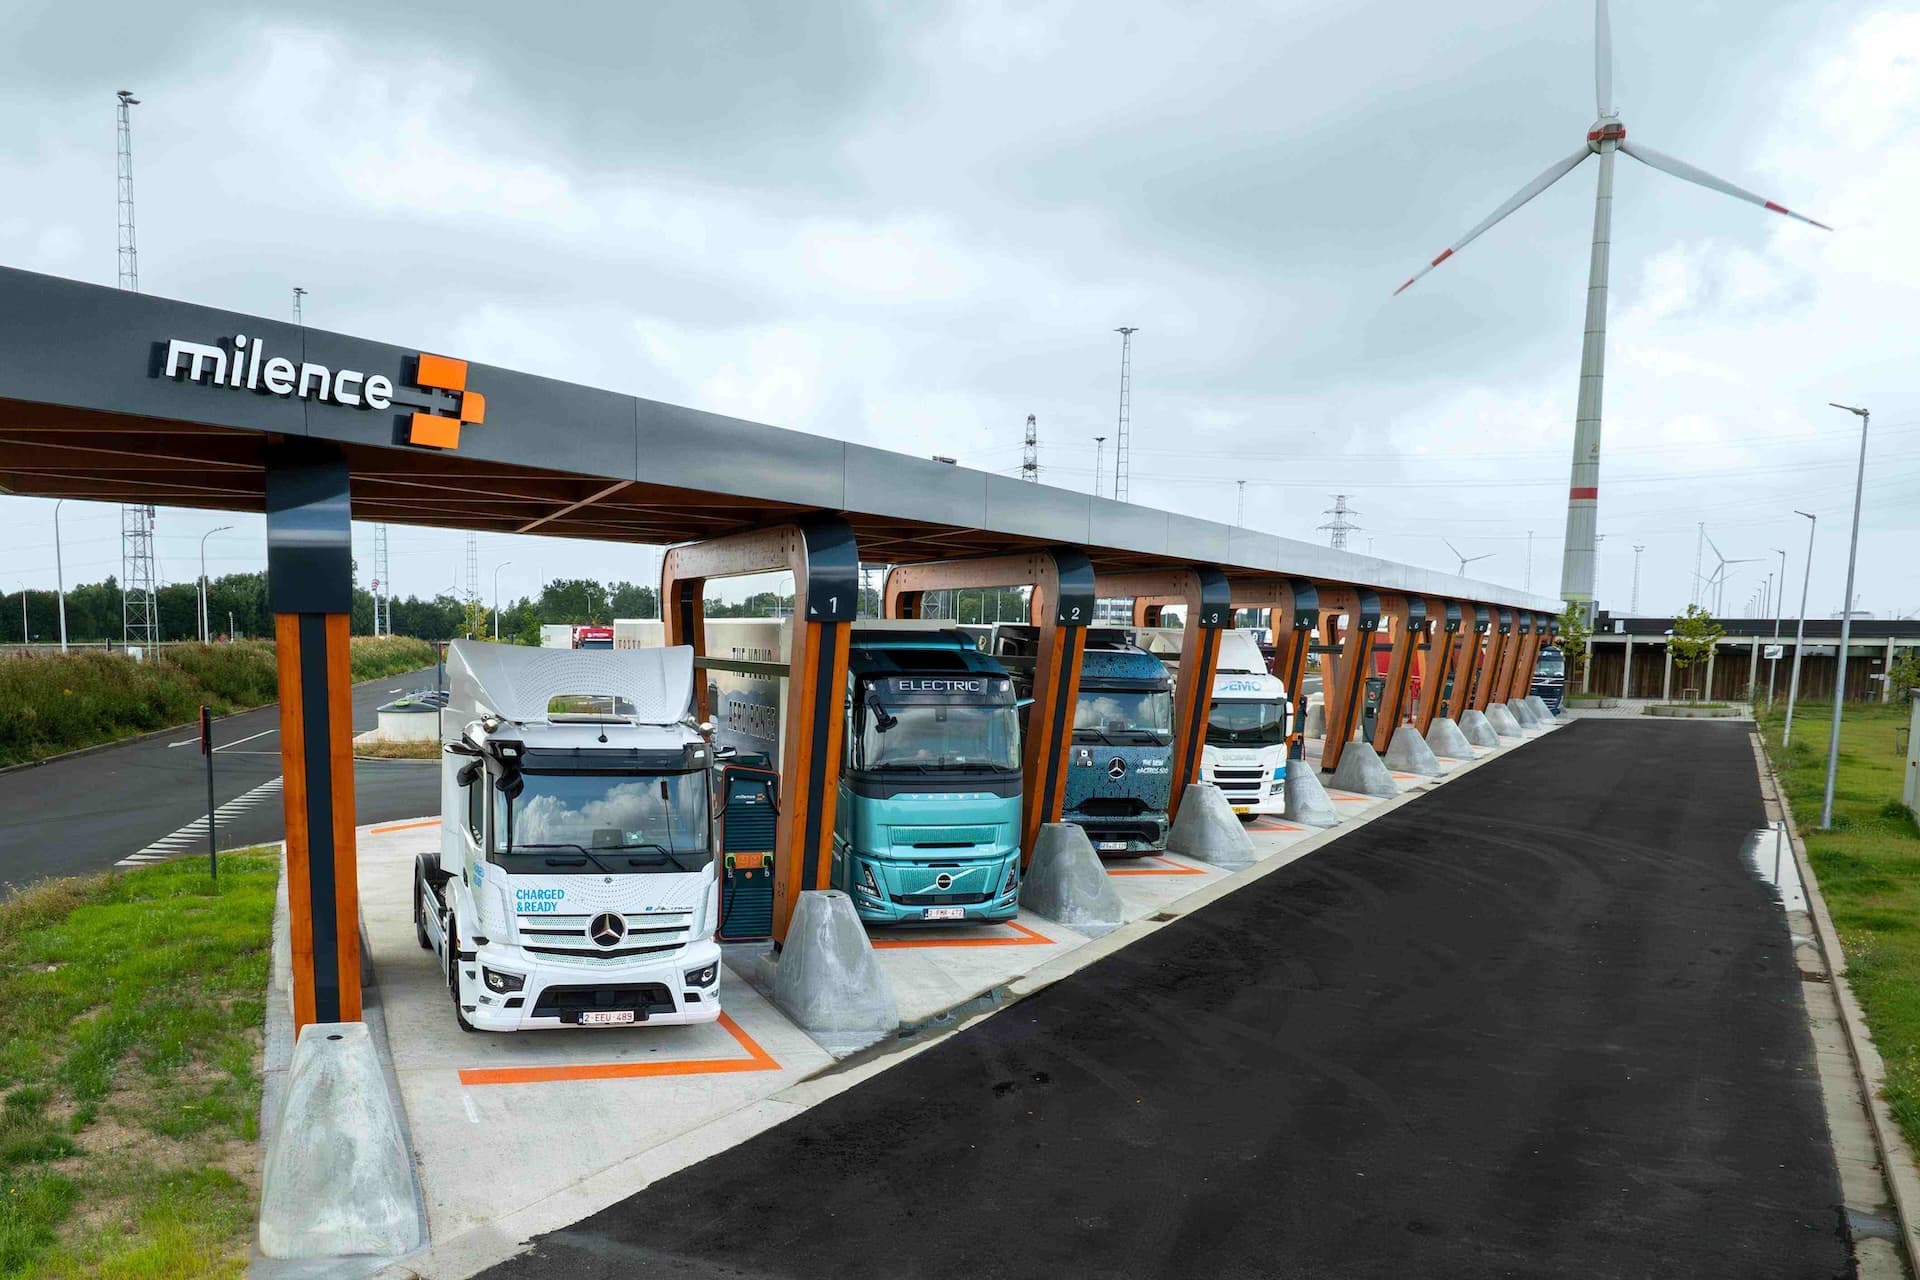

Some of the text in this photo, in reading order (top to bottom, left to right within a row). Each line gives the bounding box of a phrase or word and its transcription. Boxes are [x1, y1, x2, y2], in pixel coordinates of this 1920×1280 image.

[165, 334, 393, 410] milence
[829, 596, 838, 613] 1
[1071, 607, 1080, 620] 2
[1211, 612, 1218, 623] 3
[1302, 618, 1309, 626] 4
[1366, 620, 1372, 628] 5
[1414, 621, 1420, 629] 6
[899, 680, 980, 691] ELECTRIC
[515, 889, 565, 900] CHARGED
[516, 901, 557, 912] &READY
